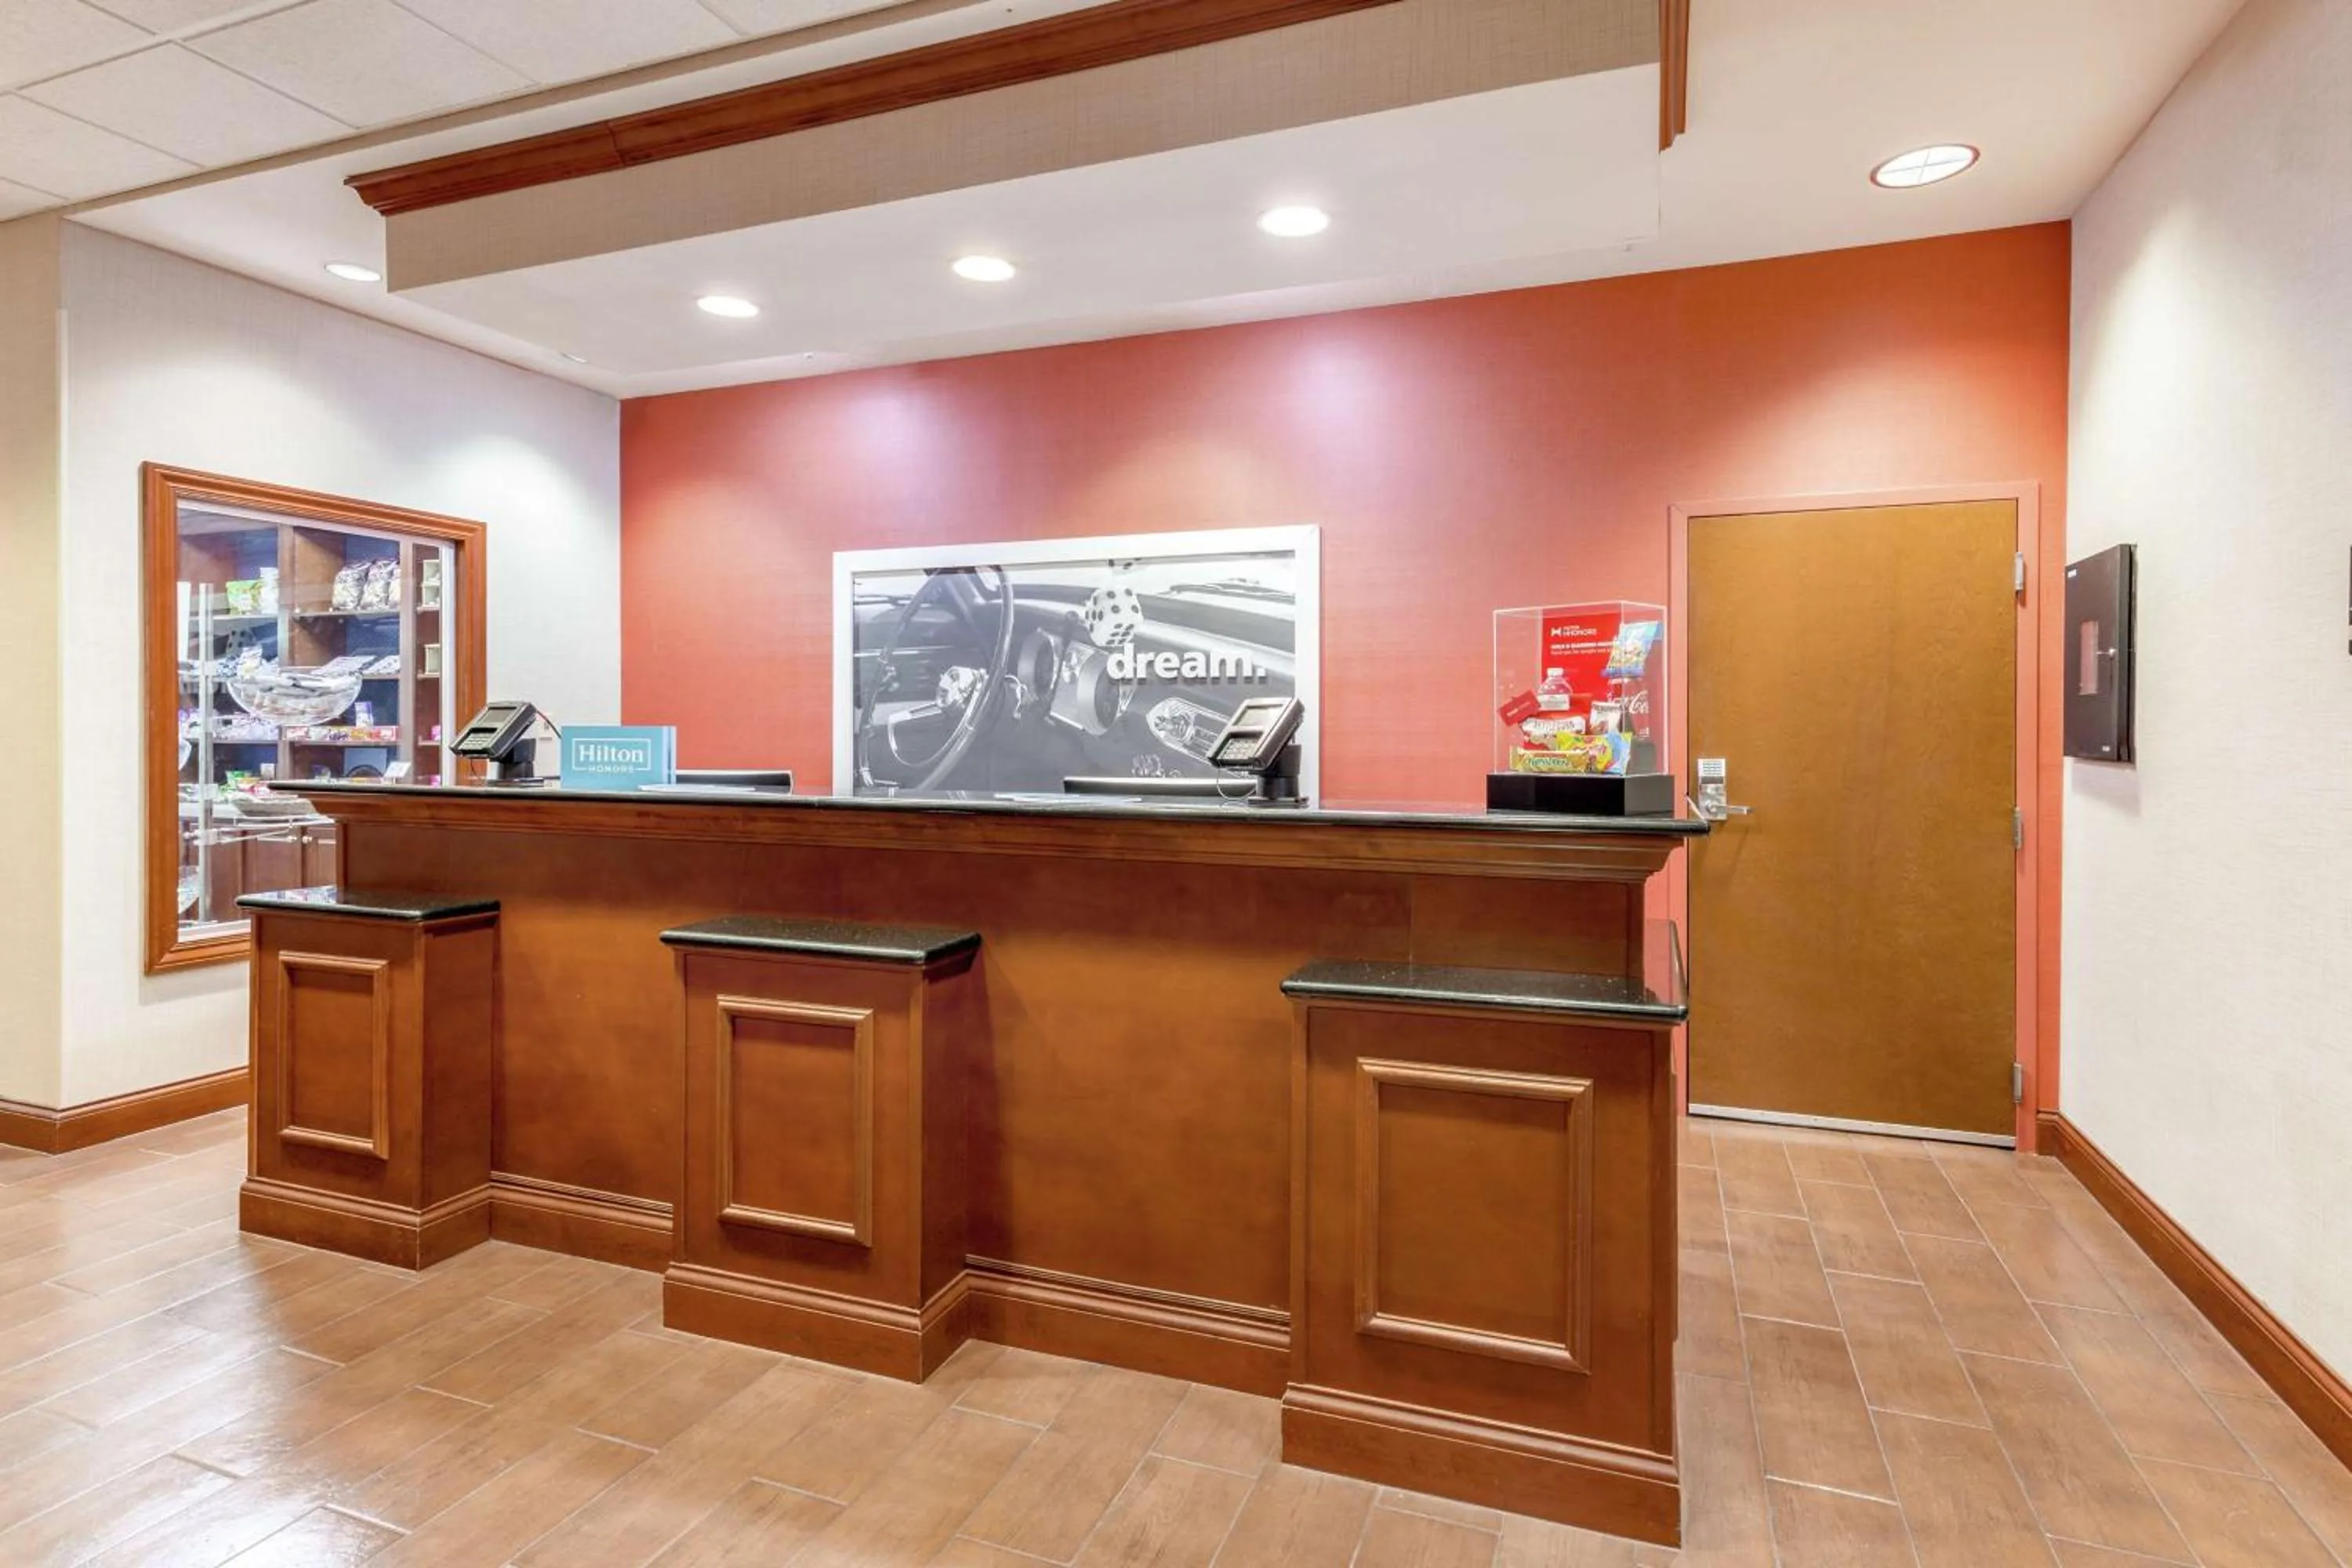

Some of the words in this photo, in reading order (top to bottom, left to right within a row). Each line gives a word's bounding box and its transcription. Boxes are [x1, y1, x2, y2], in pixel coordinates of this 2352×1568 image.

[1106, 643, 1267, 680] dream.
[579, 745, 644, 763] Hilton
[589, 764, 634, 774] HONORS
